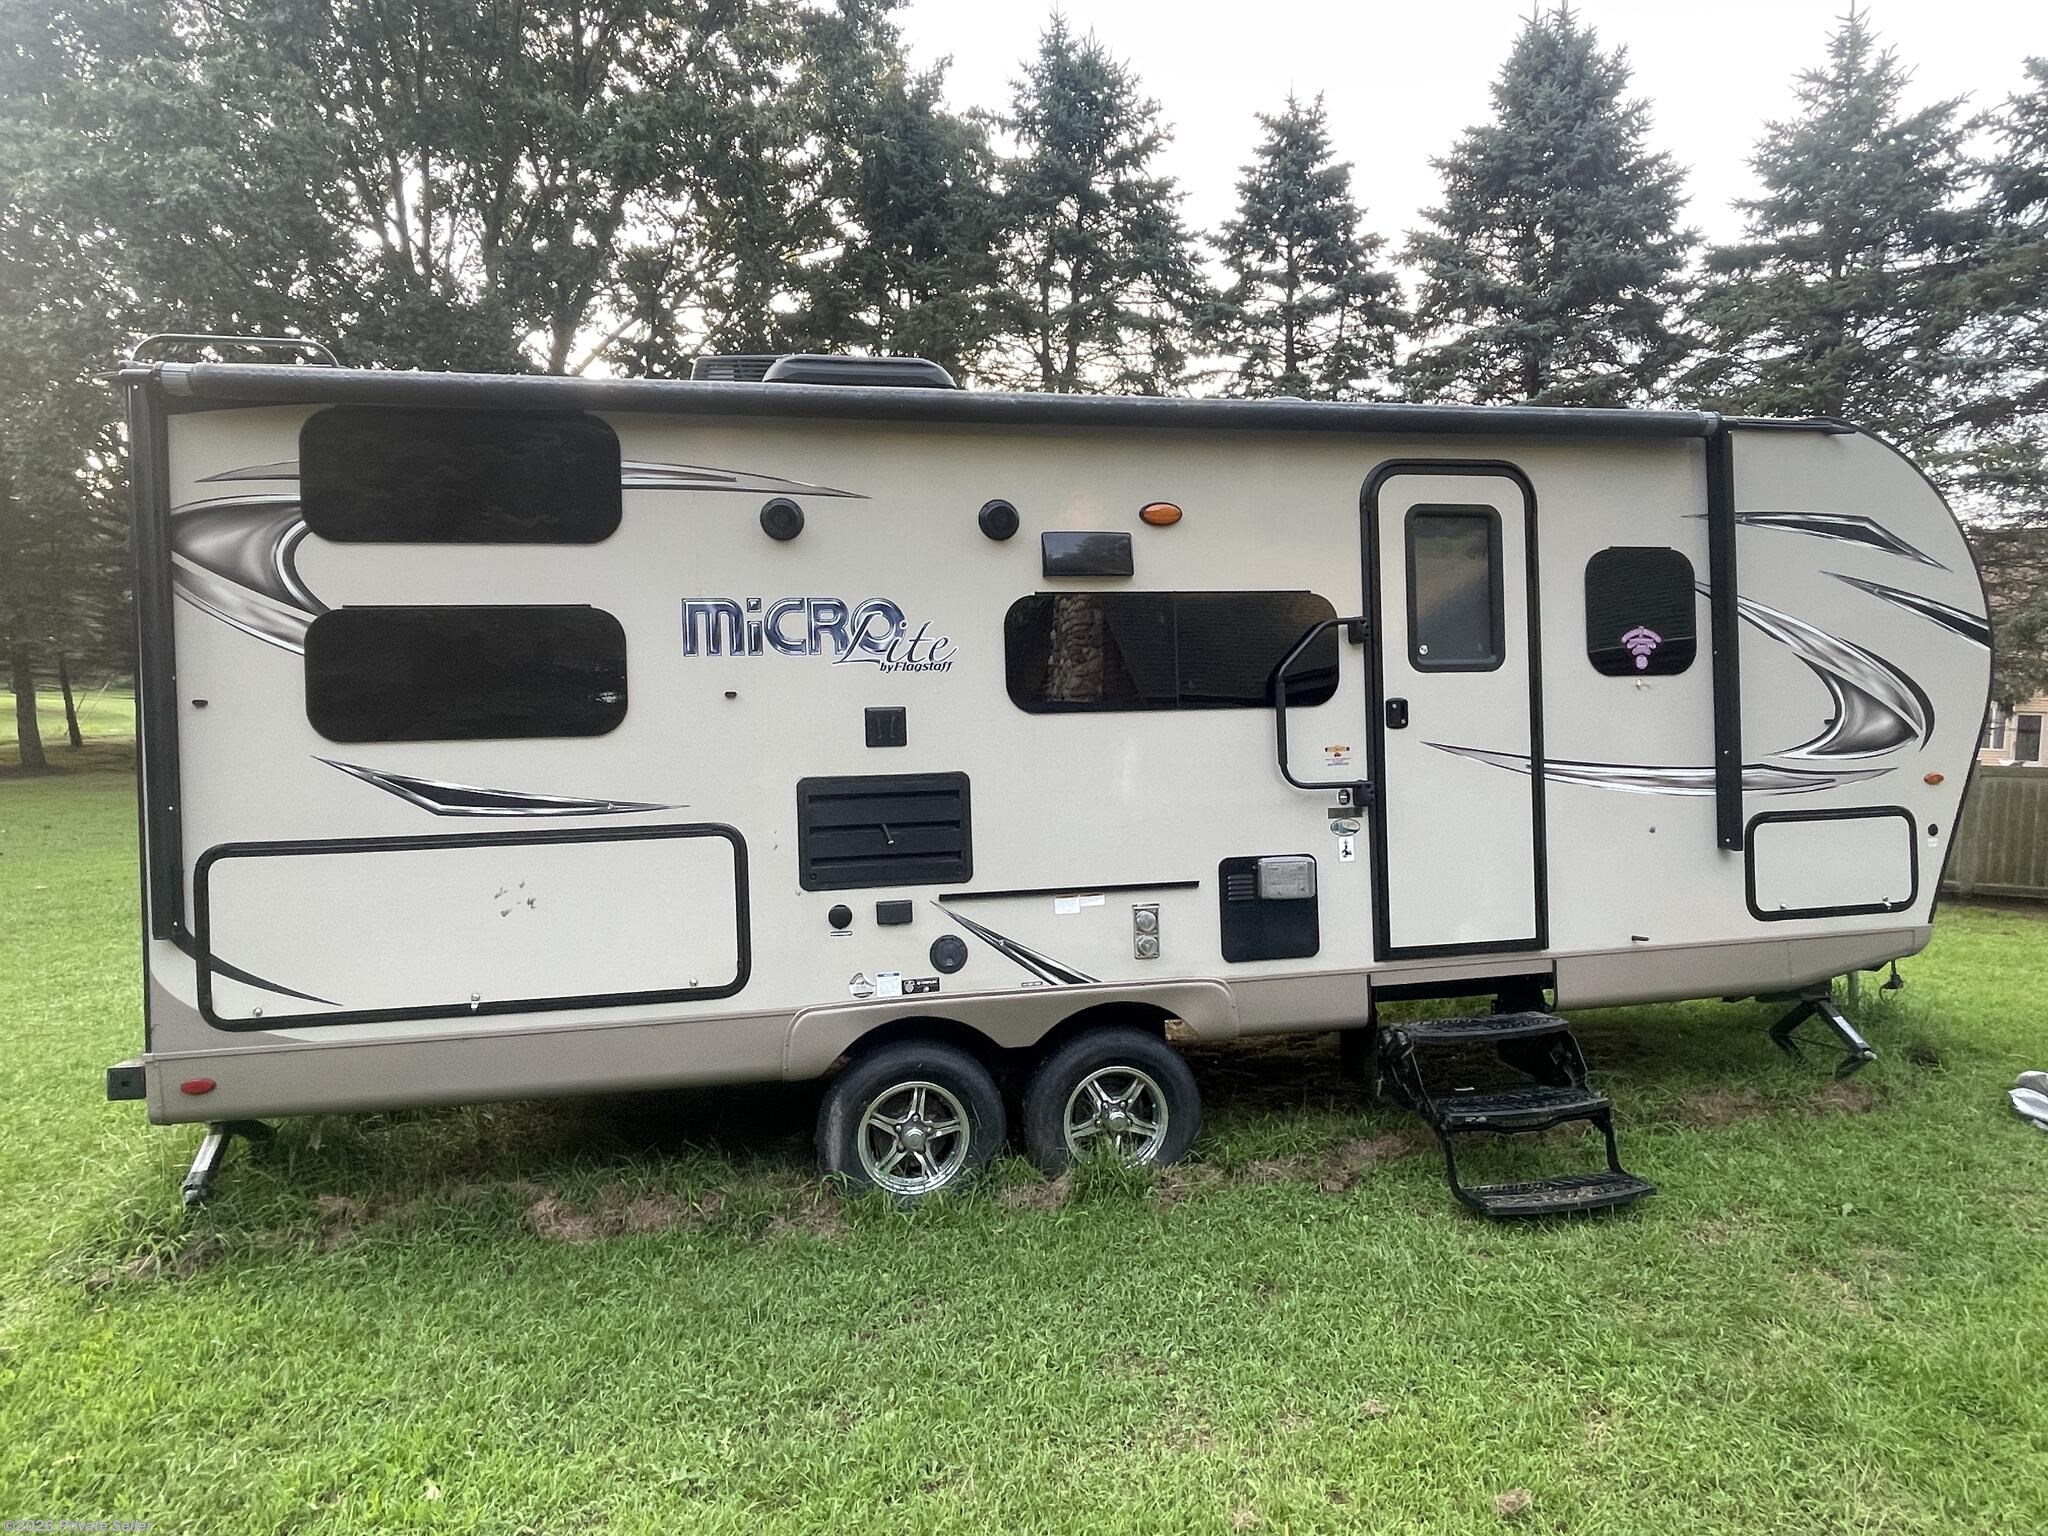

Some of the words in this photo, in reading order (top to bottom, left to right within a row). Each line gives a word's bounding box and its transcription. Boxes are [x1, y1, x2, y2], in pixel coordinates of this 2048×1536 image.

[832, 610, 957, 665] Lite
[880, 662, 894, 674] by
[894, 661, 954, 673] Flagstaff
